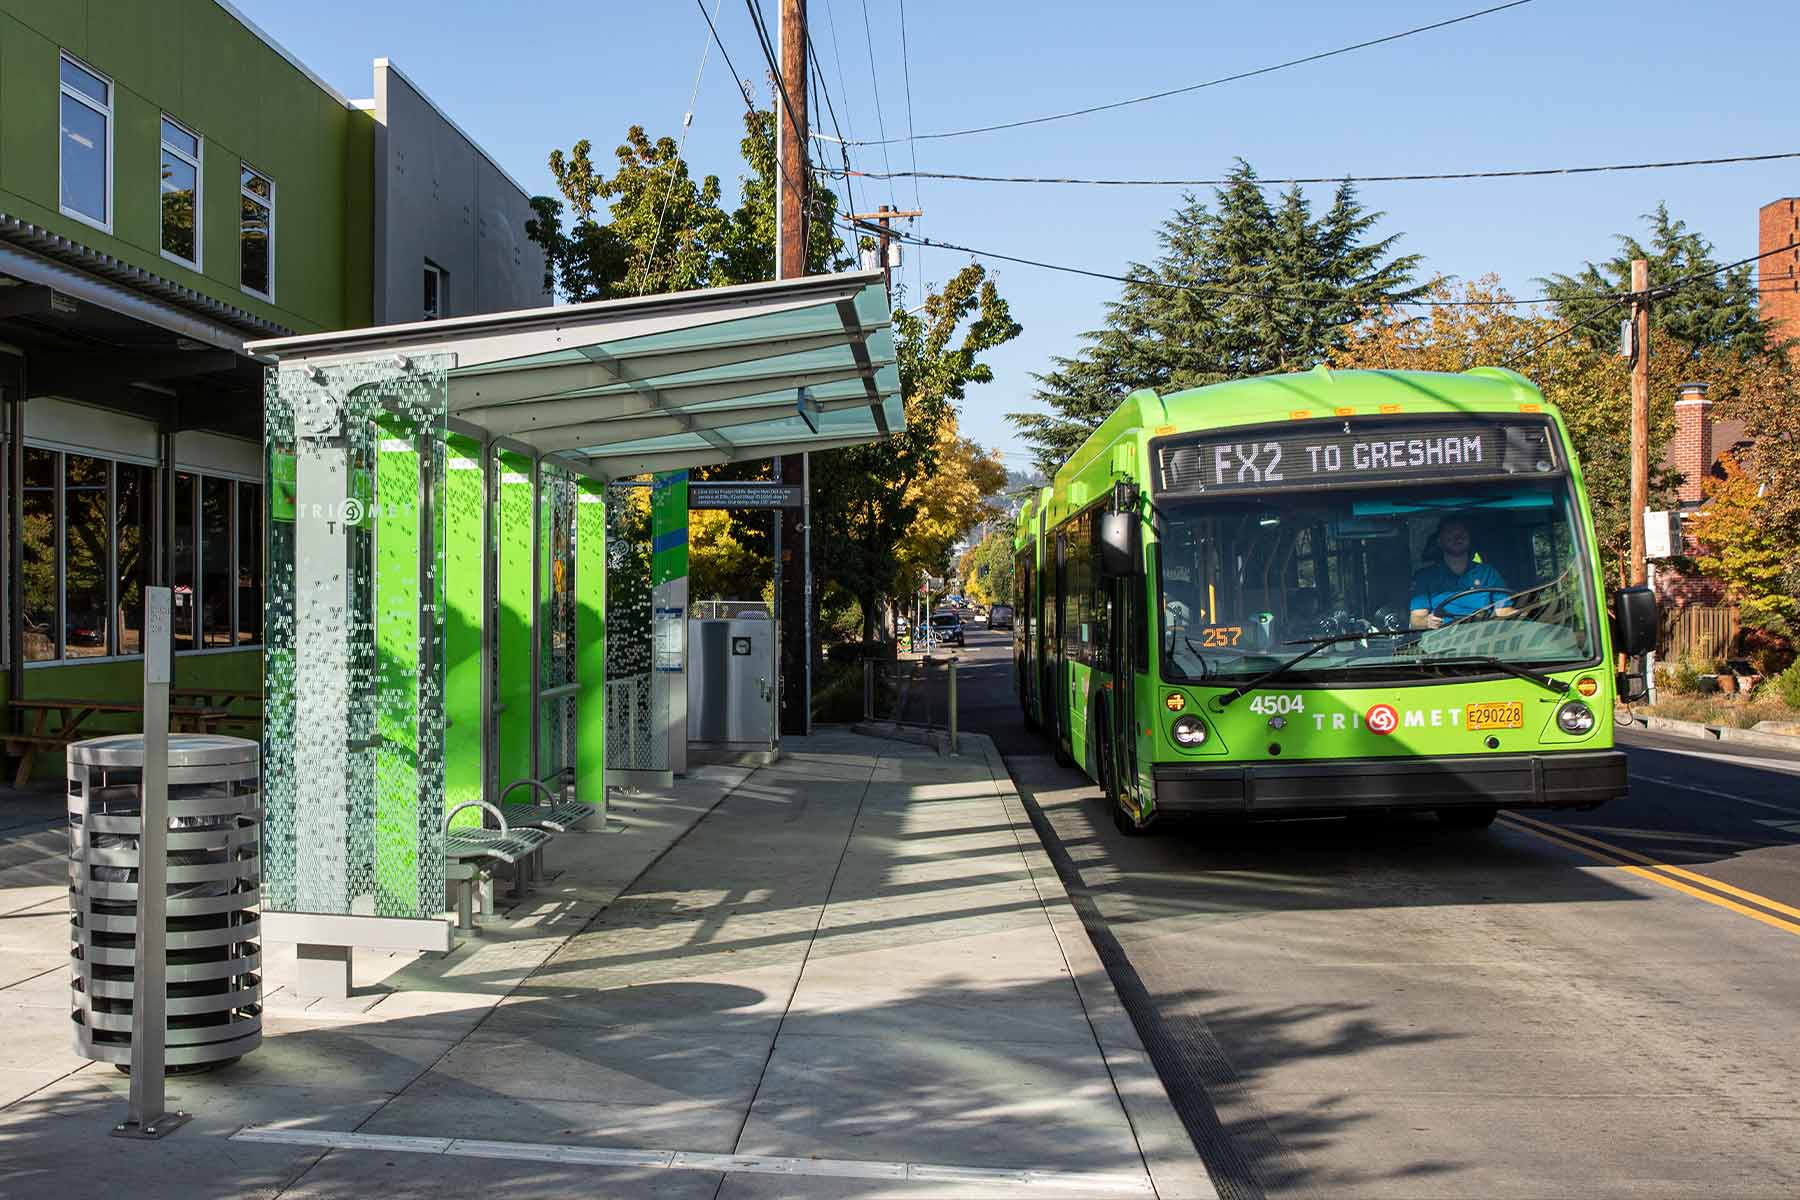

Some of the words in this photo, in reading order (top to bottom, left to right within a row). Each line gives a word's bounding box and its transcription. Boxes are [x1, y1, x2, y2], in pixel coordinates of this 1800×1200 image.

[1215, 442, 1283, 485] FX2
[1306, 446, 1341, 473] TO
[1353, 435, 1483, 470] GRESHAM
[1202, 626, 1242, 648] 257
[1249, 694, 1304, 715] 4504
[1469, 707, 1521, 724] E290228
